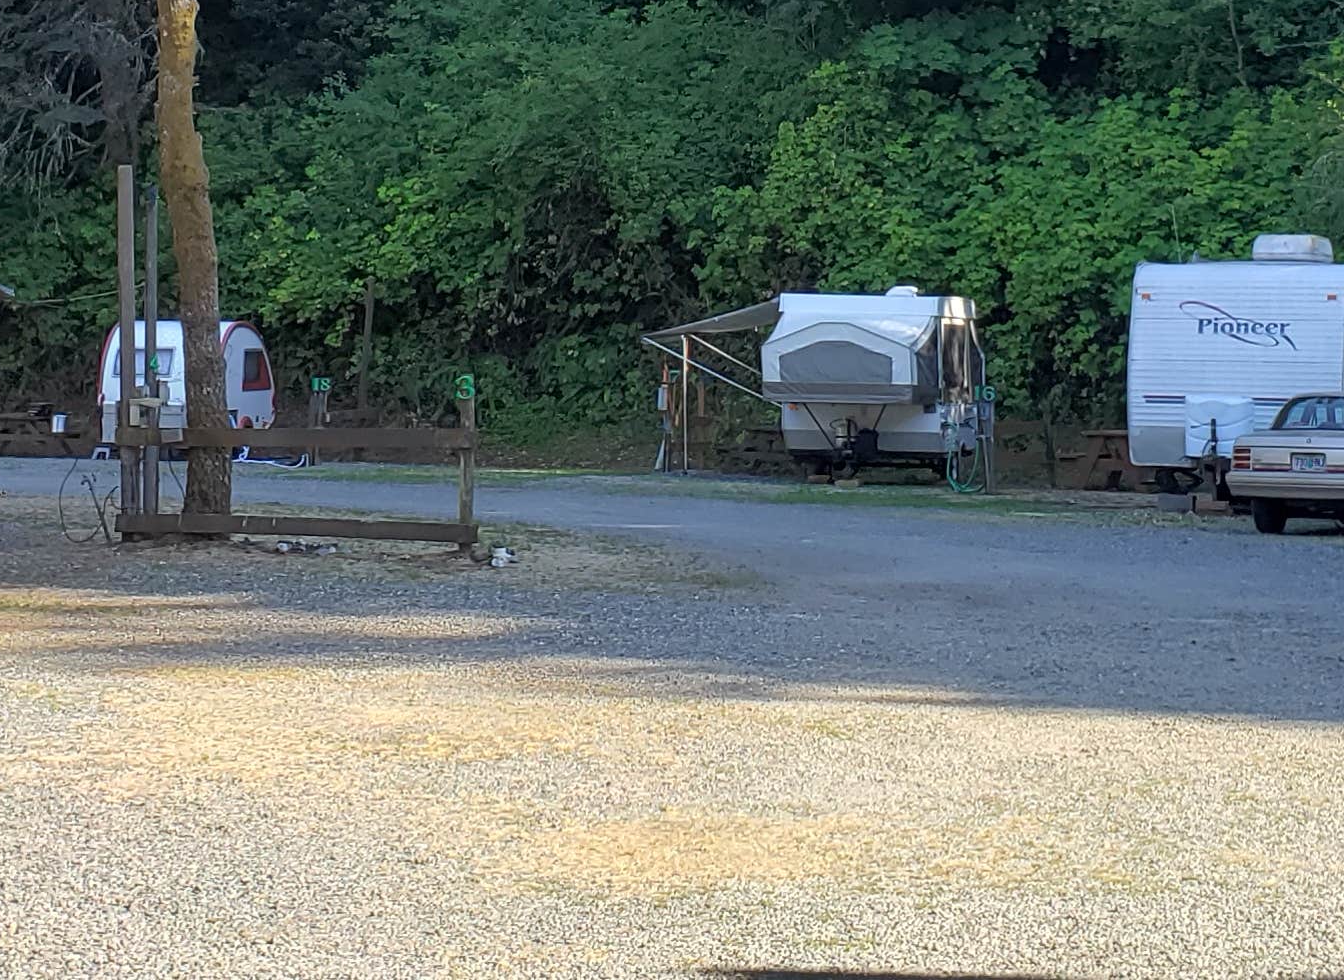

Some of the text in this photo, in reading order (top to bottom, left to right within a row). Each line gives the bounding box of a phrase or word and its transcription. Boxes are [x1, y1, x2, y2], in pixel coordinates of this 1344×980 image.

[1197, 318, 1291, 335] Pioneer
[311, 377, 331, 391] 18
[455, 374, 475, 399] 3
[974, 385, 996, 401] 16
